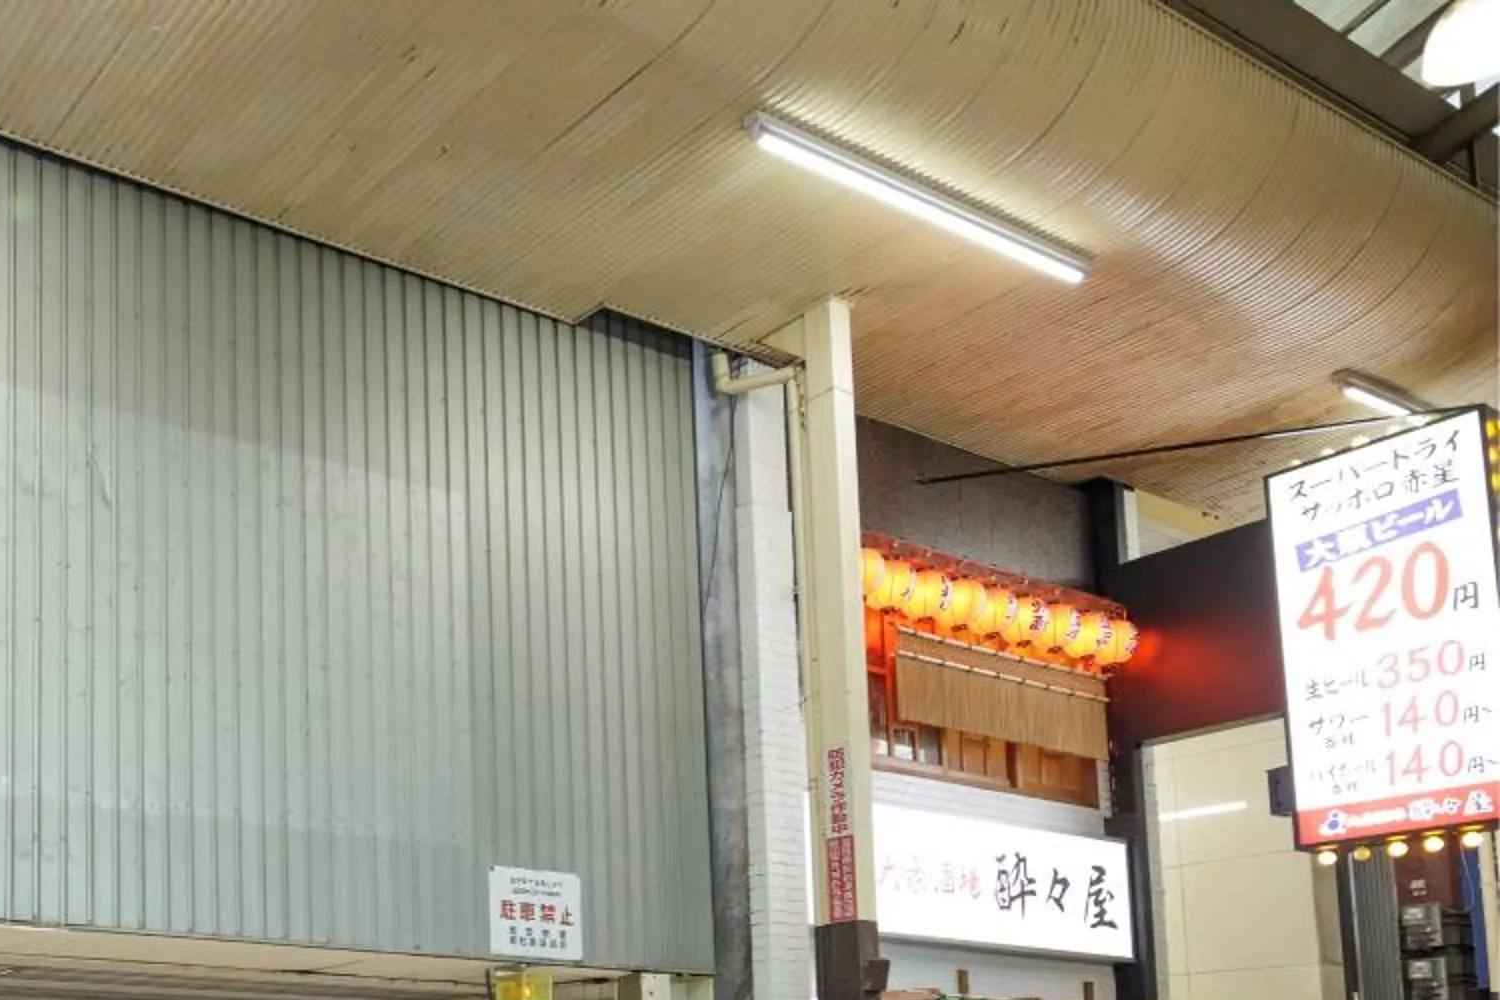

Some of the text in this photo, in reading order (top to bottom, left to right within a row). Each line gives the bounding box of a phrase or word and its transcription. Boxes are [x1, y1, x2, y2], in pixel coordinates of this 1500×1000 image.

[499, 899, 574, 927] 駐車禁止
[995, 851, 1118, 929] 酔々屋
